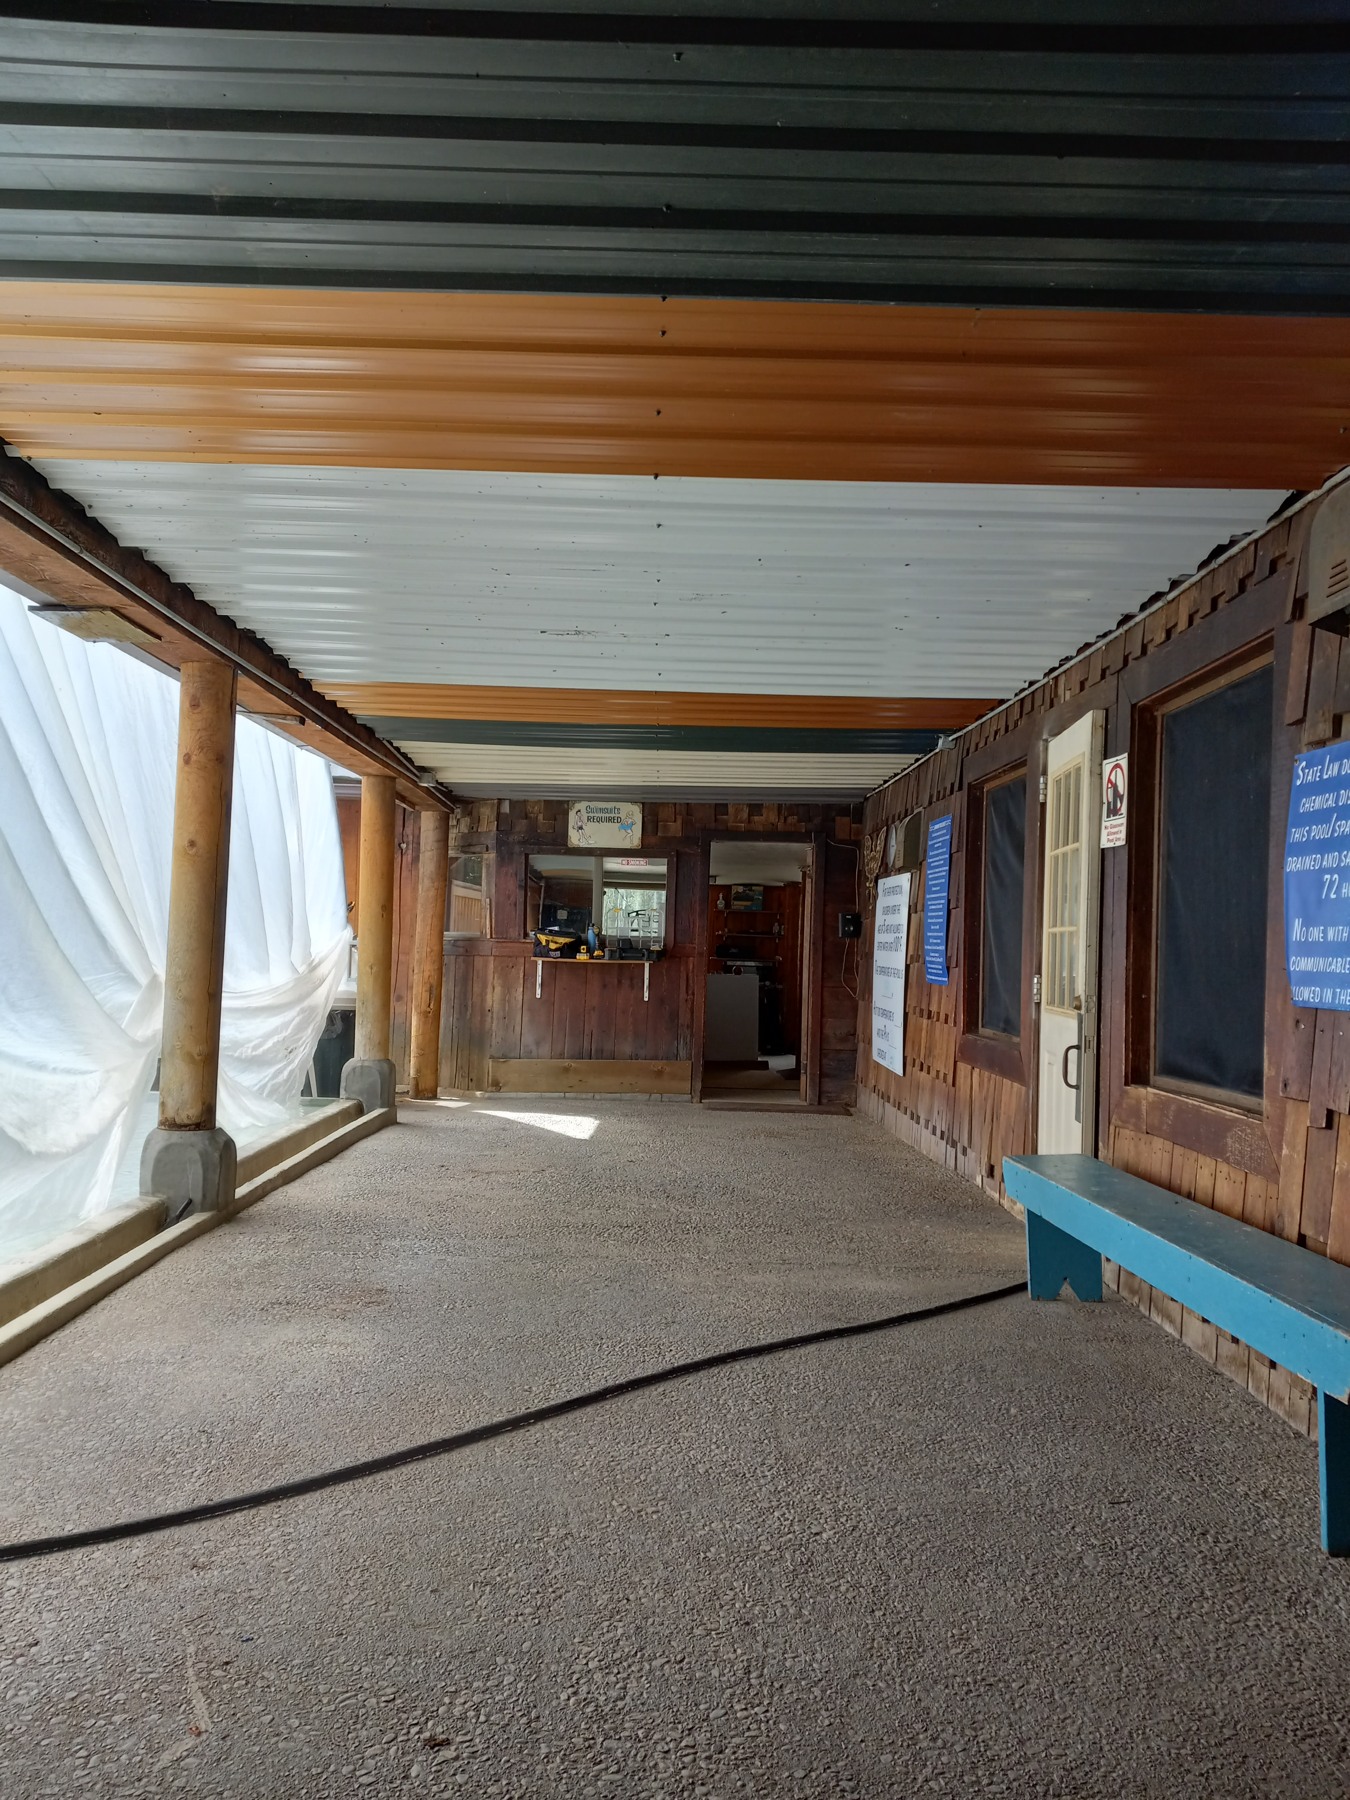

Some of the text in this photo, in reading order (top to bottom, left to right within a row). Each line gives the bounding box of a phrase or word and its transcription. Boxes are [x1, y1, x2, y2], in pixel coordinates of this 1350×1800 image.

[585, 805, 621, 815] Swimsuits
[1300, 792, 1337, 813] CHEMICAL
[587, 816, 622, 824] REQUIRED
[1290, 826, 1309, 843] THIS
[1286, 854, 1322, 872] DRAINED
[1322, 852, 1339, 868] AND
[1322, 873, 1350, 899] 72 H
[1308, 926, 1325, 942] ONE
[1327, 926, 1350, 942] WITH
[1290, 956, 1350, 973] COMMUNICABLE
[1292, 986, 1321, 1003] LLOWED
[1322, 988, 1334, 1004] IN
